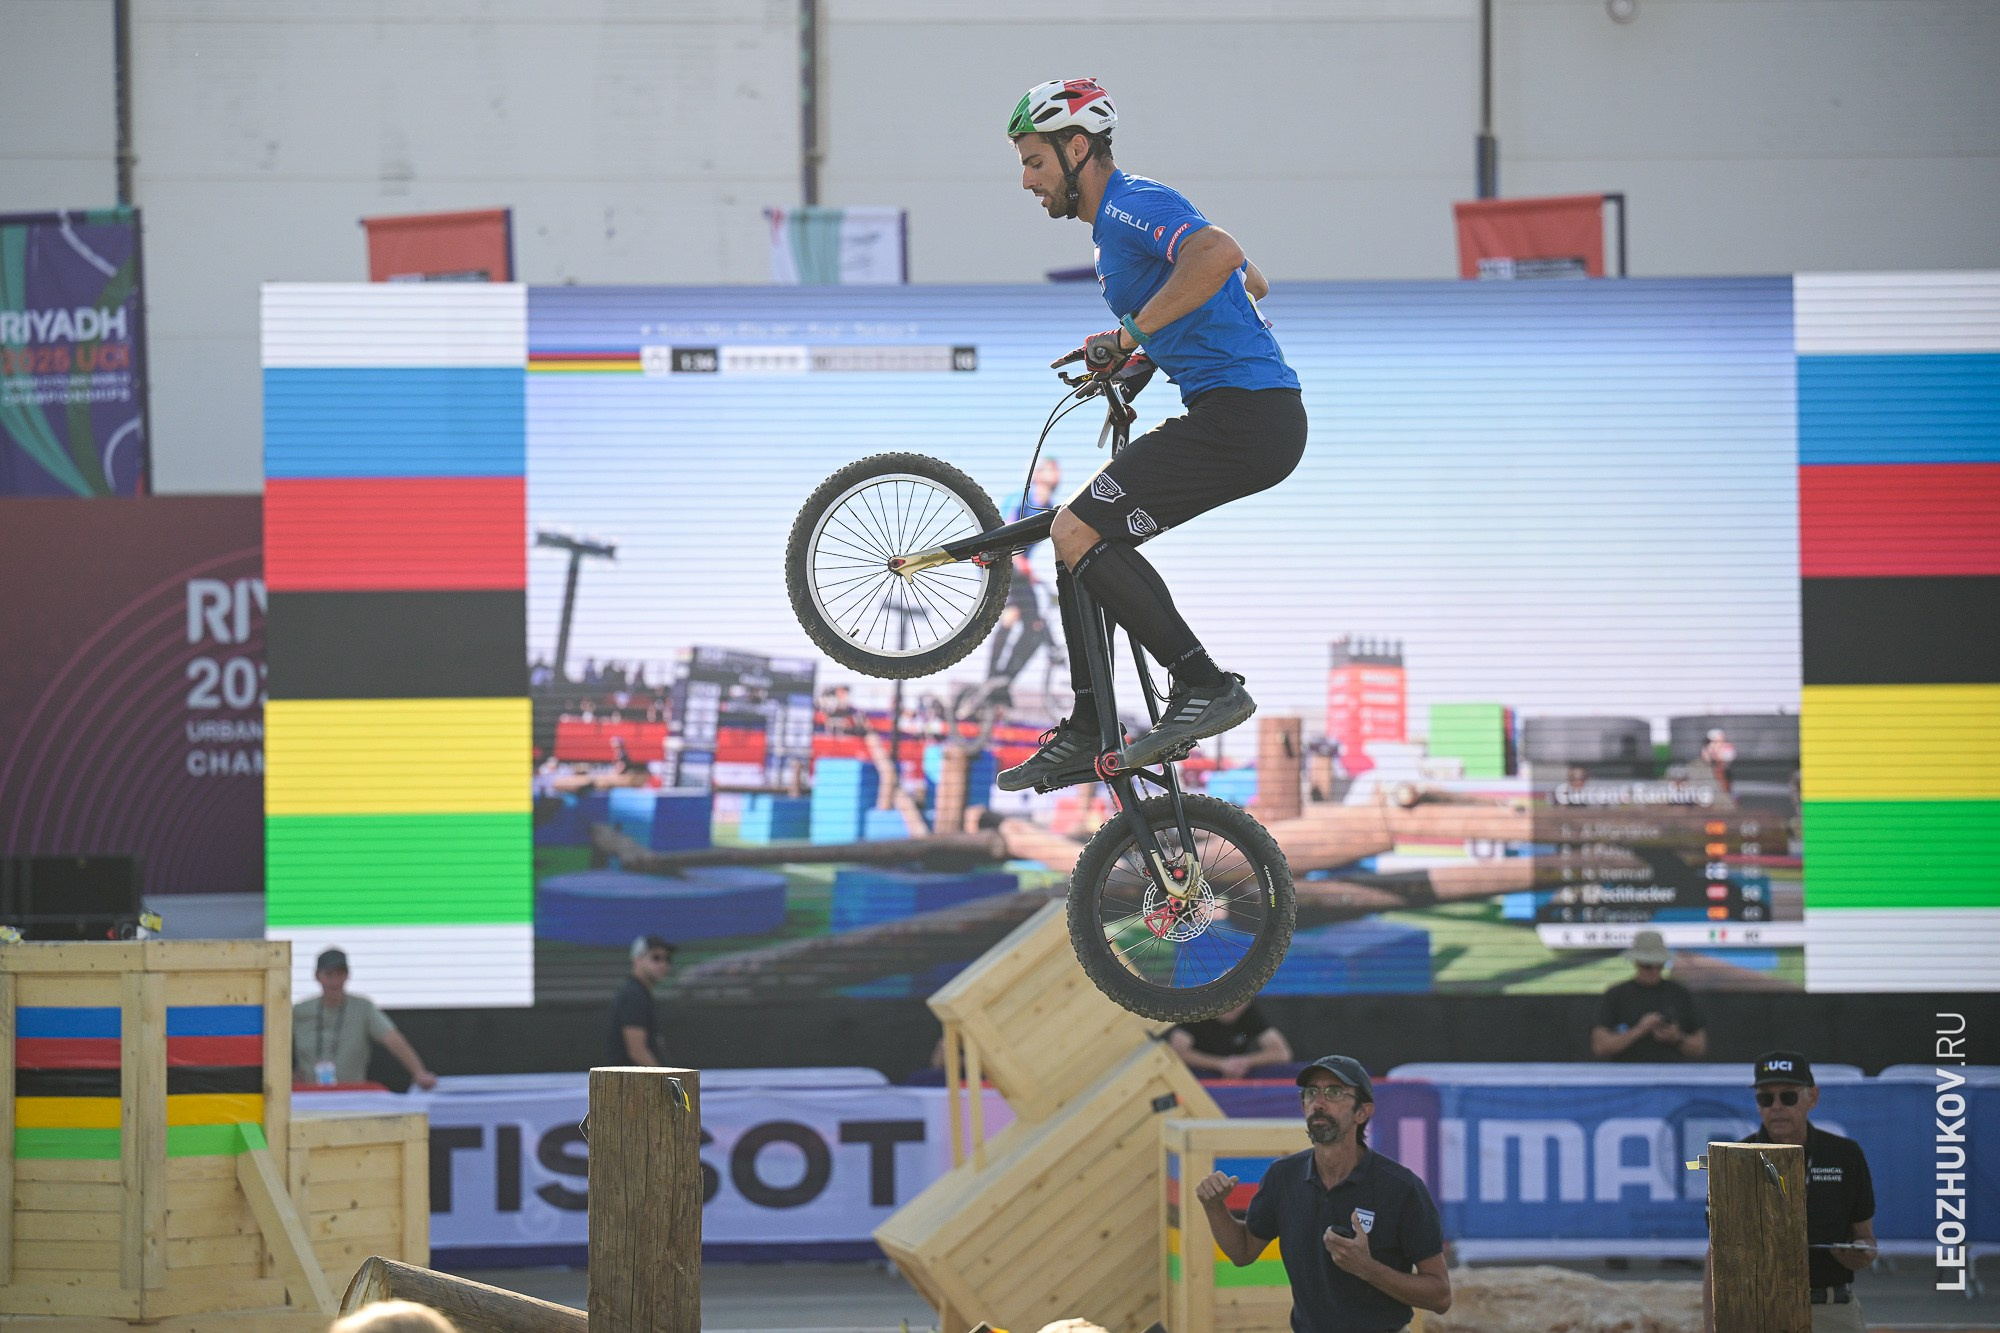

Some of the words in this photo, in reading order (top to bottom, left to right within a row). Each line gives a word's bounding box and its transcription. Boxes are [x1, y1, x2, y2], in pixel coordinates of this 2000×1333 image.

[0, 306, 127, 344] RIYADH
[186, 656, 268, 710] 20
[1554, 784, 1629, 806] Current
[1631, 781, 1714, 808] Ranking
[1767, 1060, 1793, 1072] UCI
[429, 1119, 926, 1213] TISOT
